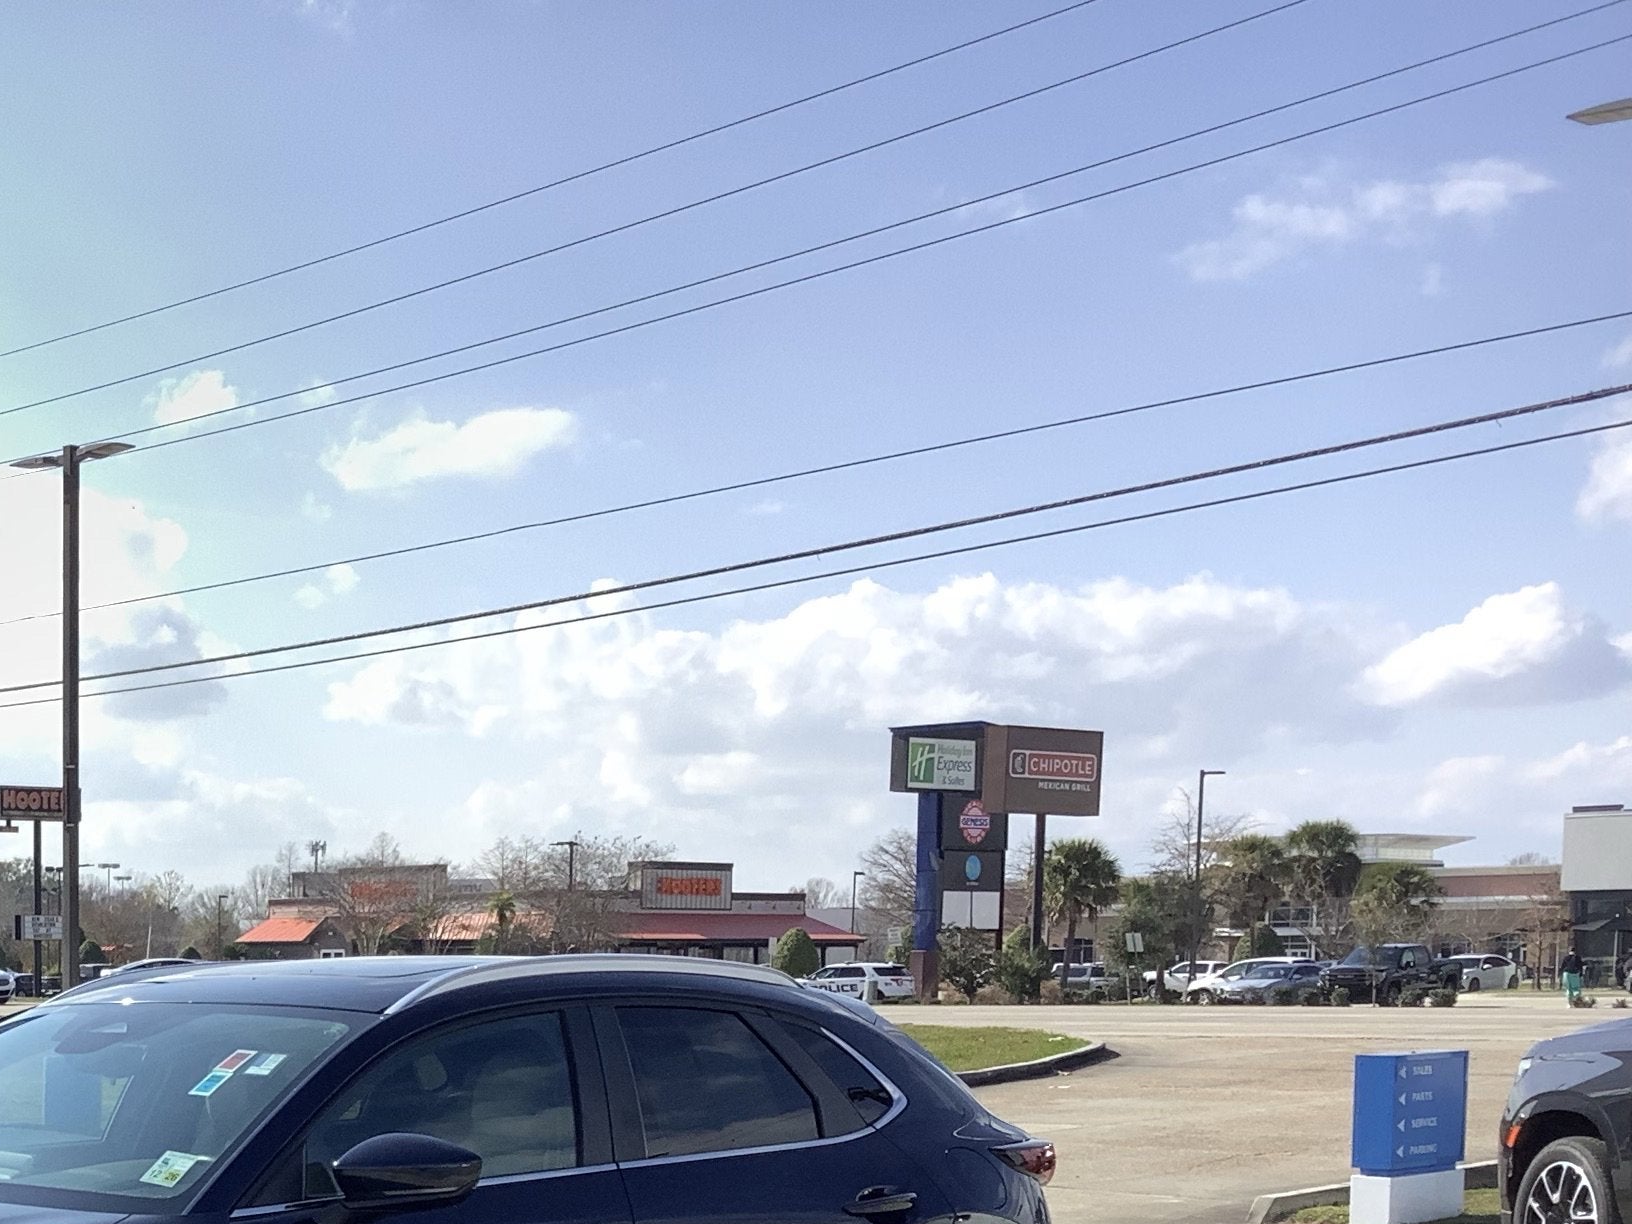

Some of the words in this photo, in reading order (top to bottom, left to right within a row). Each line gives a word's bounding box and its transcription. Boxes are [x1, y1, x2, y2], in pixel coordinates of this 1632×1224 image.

[936, 756, 973, 773] Express
[1030, 757, 1093, 775] CHIPOTLE
[948, 777, 965, 785] Suites
[1038, 781, 1070, 791] MEXICAN
[1071, 783, 1092, 792] GRILL
[2, 789, 63, 810] HOOTE
[1412, 1091, 1433, 1100] PARTS
[1411, 1117, 1437, 1128] SERVICE
